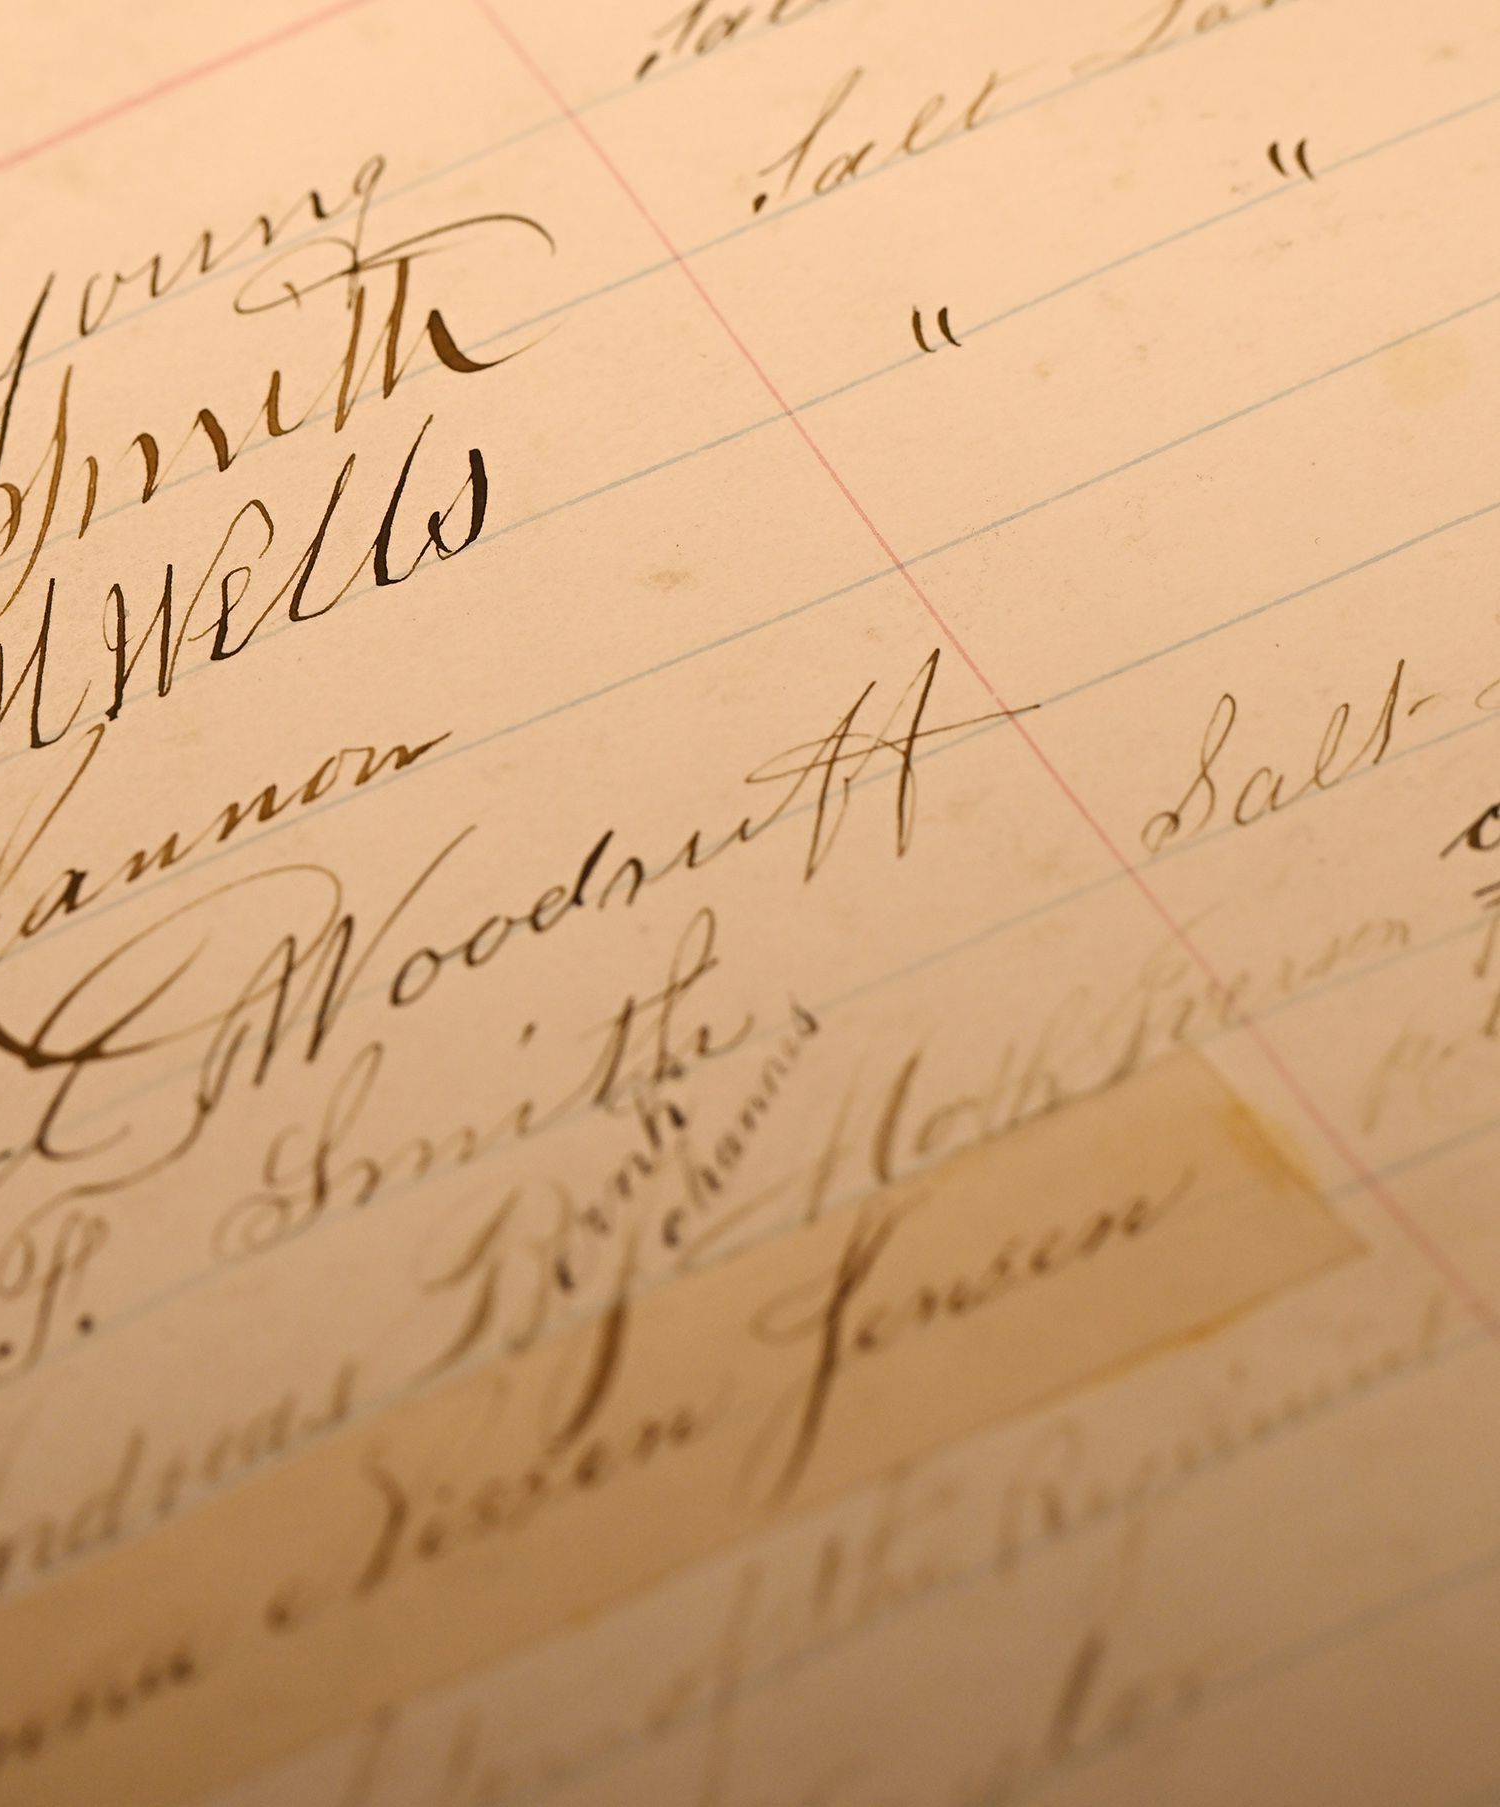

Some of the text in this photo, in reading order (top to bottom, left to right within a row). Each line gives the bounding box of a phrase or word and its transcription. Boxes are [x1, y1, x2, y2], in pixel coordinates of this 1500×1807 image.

[100, 412, 490, 723] Wells
[190, 646, 1042, 1115] Woodruff
[210, 905, 757, 1262] Smith
